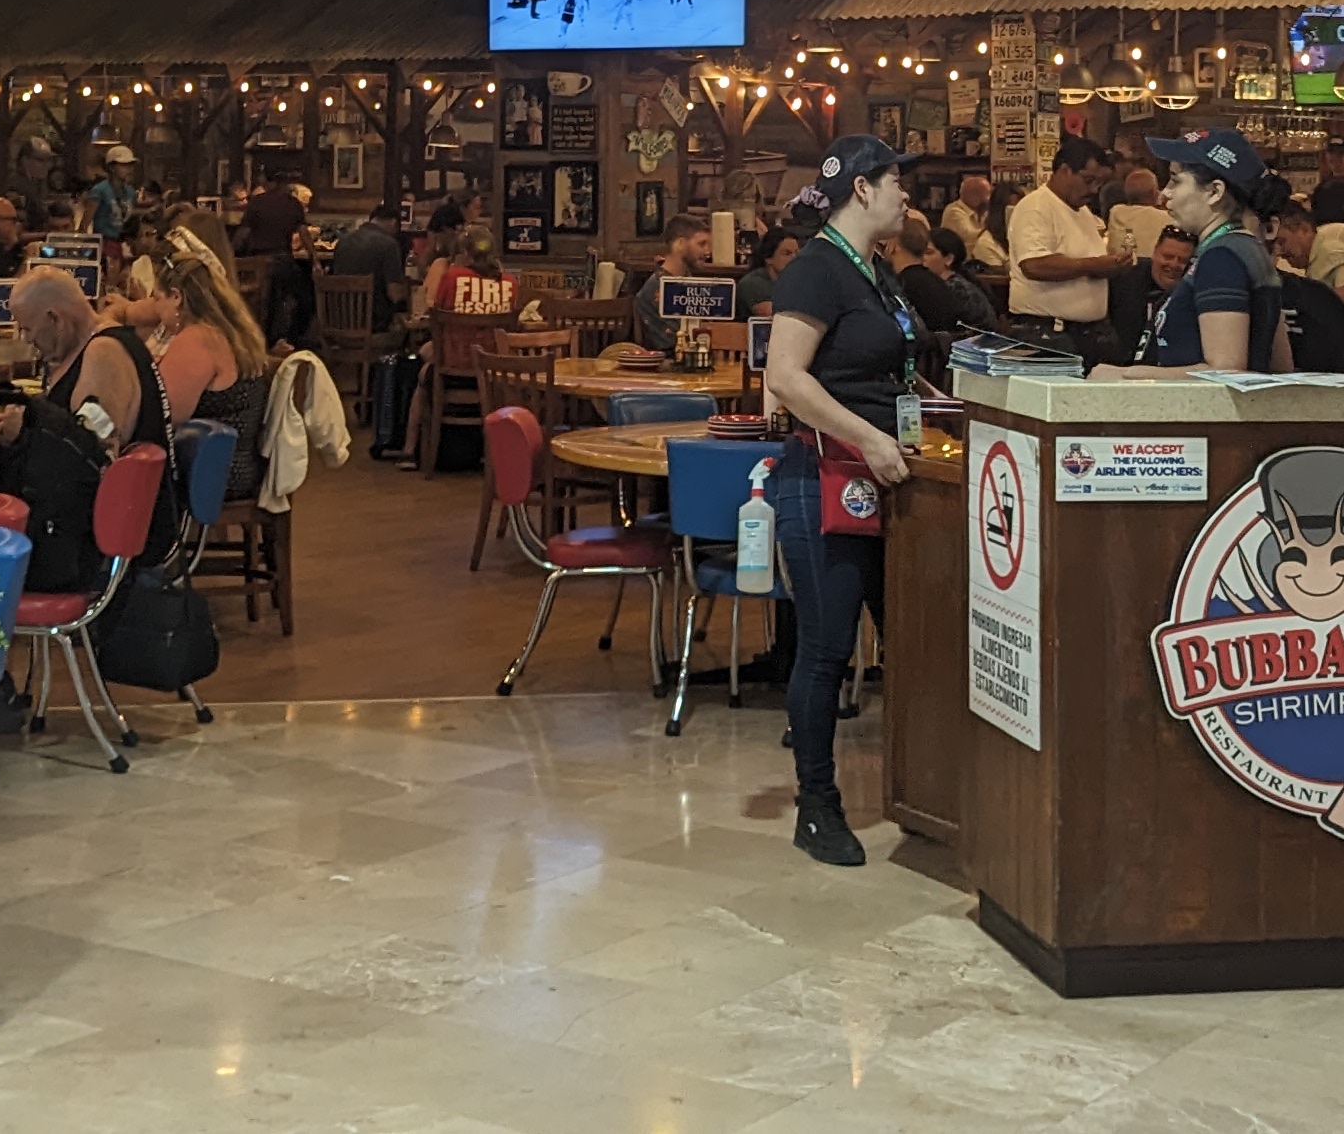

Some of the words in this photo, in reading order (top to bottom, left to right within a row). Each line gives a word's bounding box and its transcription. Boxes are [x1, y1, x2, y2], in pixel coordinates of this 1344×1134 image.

[455, 276, 513, 304] FIRE
[672, 296, 724, 307] FORREST
[686, 286, 711, 297] RUN
[685, 306, 710, 316] RUN
[1113, 444, 1134, 455] WE
[1135, 444, 1184, 455] ACCEPT
[1094, 467, 1136, 476] AIRLINE
[1140, 467, 1203, 476] VOUCHERS:
[971, 608, 1000, 638] PROHIBIDO
[1001, 623, 1032, 654] INGRESAR
[981, 633, 1013, 666] ALIMENTOS
[973, 648, 996, 677] BEBIDAS
[997, 662, 1020, 691] AJENOS
[1021, 675, 1030, 696] AL
[975, 671, 1028, 716] ESTABLECIMIENTO
[1203, 710, 1329, 805] RESTAURANT
